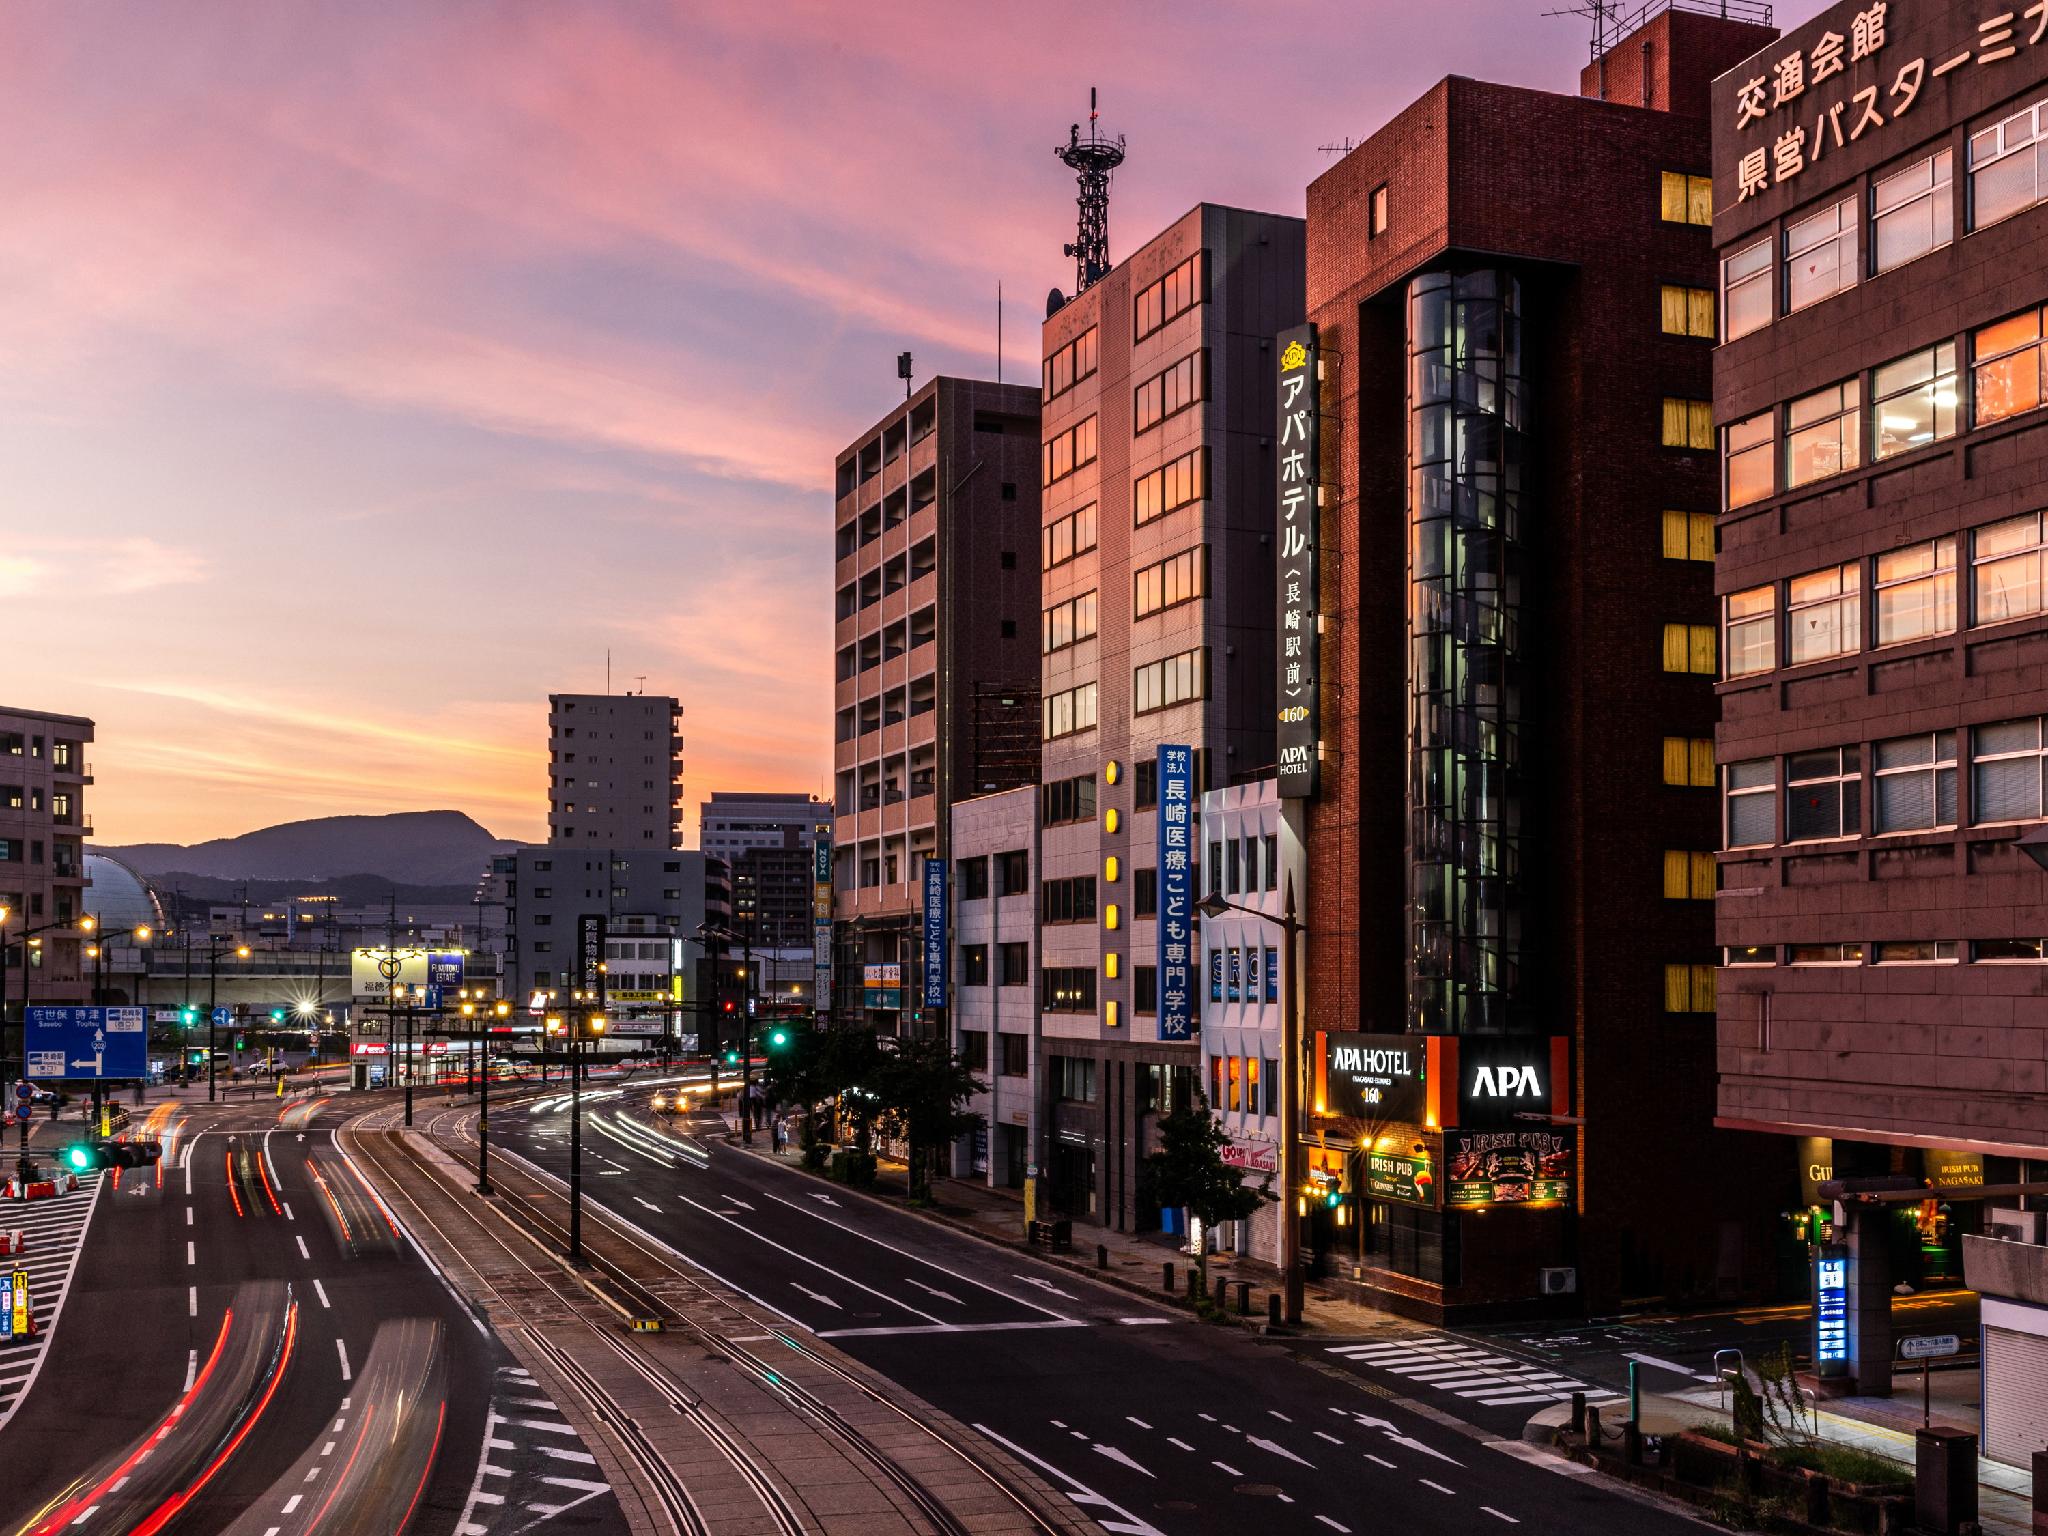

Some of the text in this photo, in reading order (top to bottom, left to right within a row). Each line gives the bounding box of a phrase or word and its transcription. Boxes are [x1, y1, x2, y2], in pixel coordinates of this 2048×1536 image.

[1735, 1, 1888, 131] 交通会館
[1281, 374, 1306, 559] アパホテル
[1282, 706, 1304, 723] 160
[1280, 746, 1308, 764] APA
[1280, 763, 1308, 775] HOTEL
[818, 848, 828, 876] NOVA
[1165, 779, 1187, 1035] 長崎医療こども専門学校
[928, 873, 942, 998] 長崎医療こども専門学校
[431, 963, 460, 973] FUKUTOKU
[435, 973, 456, 983] ESTATE
[33, 1009, 100, 1020] 佐世保 時津
[1334, 1047, 1412, 1076] APA HOTEL
[1471, 1065, 1543, 1098] APA
[1364, 1087, 1379, 1104] 160
[1472, 1132, 1551, 1155] IRISH PUB
[1370, 1157, 1413, 1177] IRISH PUB
[1941, 1163, 1979, 1173] IRISH PUB
[1938, 1175, 1984, 1186] NAGASAKI
